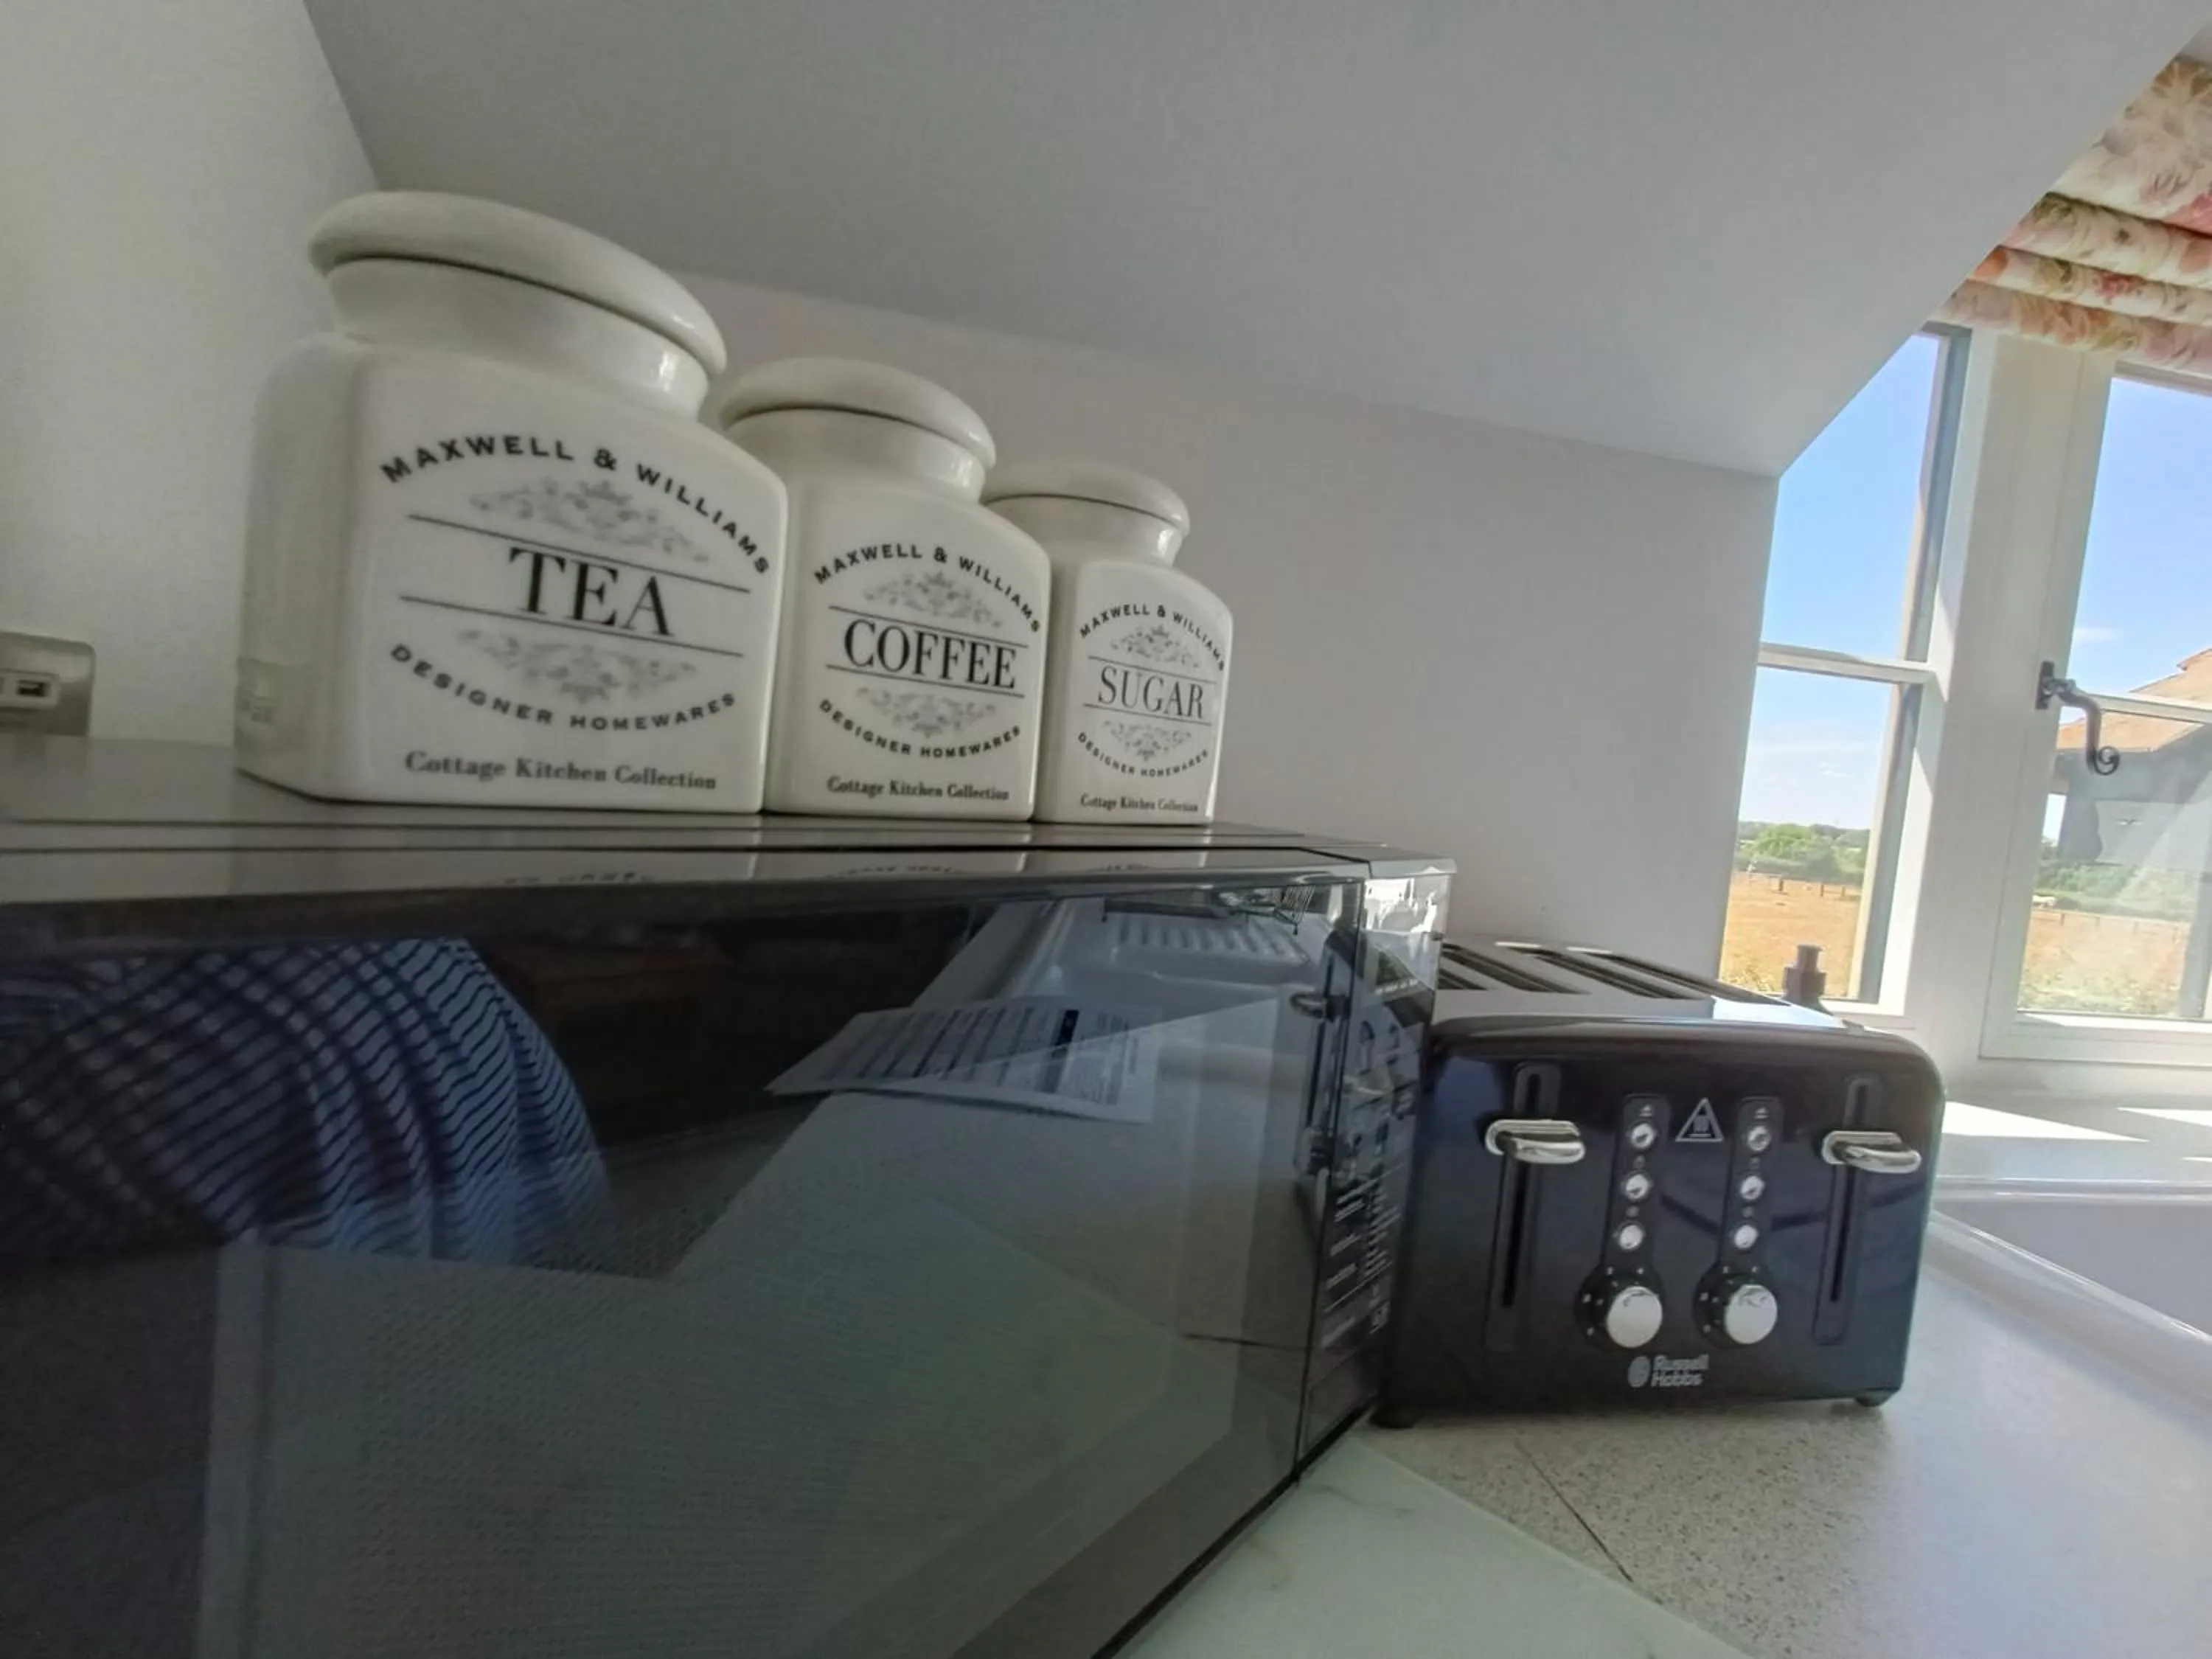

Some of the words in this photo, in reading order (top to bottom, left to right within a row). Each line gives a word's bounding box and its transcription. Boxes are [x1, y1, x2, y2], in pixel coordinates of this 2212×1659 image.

[380, 435, 574, 483] MAXWELL
[594, 448, 617, 471] &
[636, 463, 769, 574] WILLIAMS
[508, 546, 674, 637] TEA
[814, 543, 923, 585] MAXWELL
[933, 546, 947, 563] &
[959, 556, 1040, 632] WILLIAMS
[844, 619, 1016, 689] COFFEE
[1079, 603, 1150, 639] MAXWELL
[1157, 604, 1166, 618] &
[1172, 612, 1225, 671] WILLIAMS
[391, 644, 554, 725] DESIGNER
[570, 693, 735, 731] HOMEWARES
[1099, 666, 1204, 719] SUGAR
[819, 699, 911, 755] DESIGNER
[920, 725, 1020, 758] HOMEWARES
[1078, 732, 1135, 775] DESIGNER
[1141, 749, 1208, 777] HOMEWARES
[405, 751, 506, 782] Cottage
[515, 758, 606, 782] Kitchen
[615, 765, 716, 790] Collection
[827, 776, 885, 799] Cottage
[889, 780, 944, 798] Kitchen
[947, 784, 1010, 801] Collection
[1080, 793, 1117, 811] Cottage
[1121, 796, 1155, 811] Kitchen
